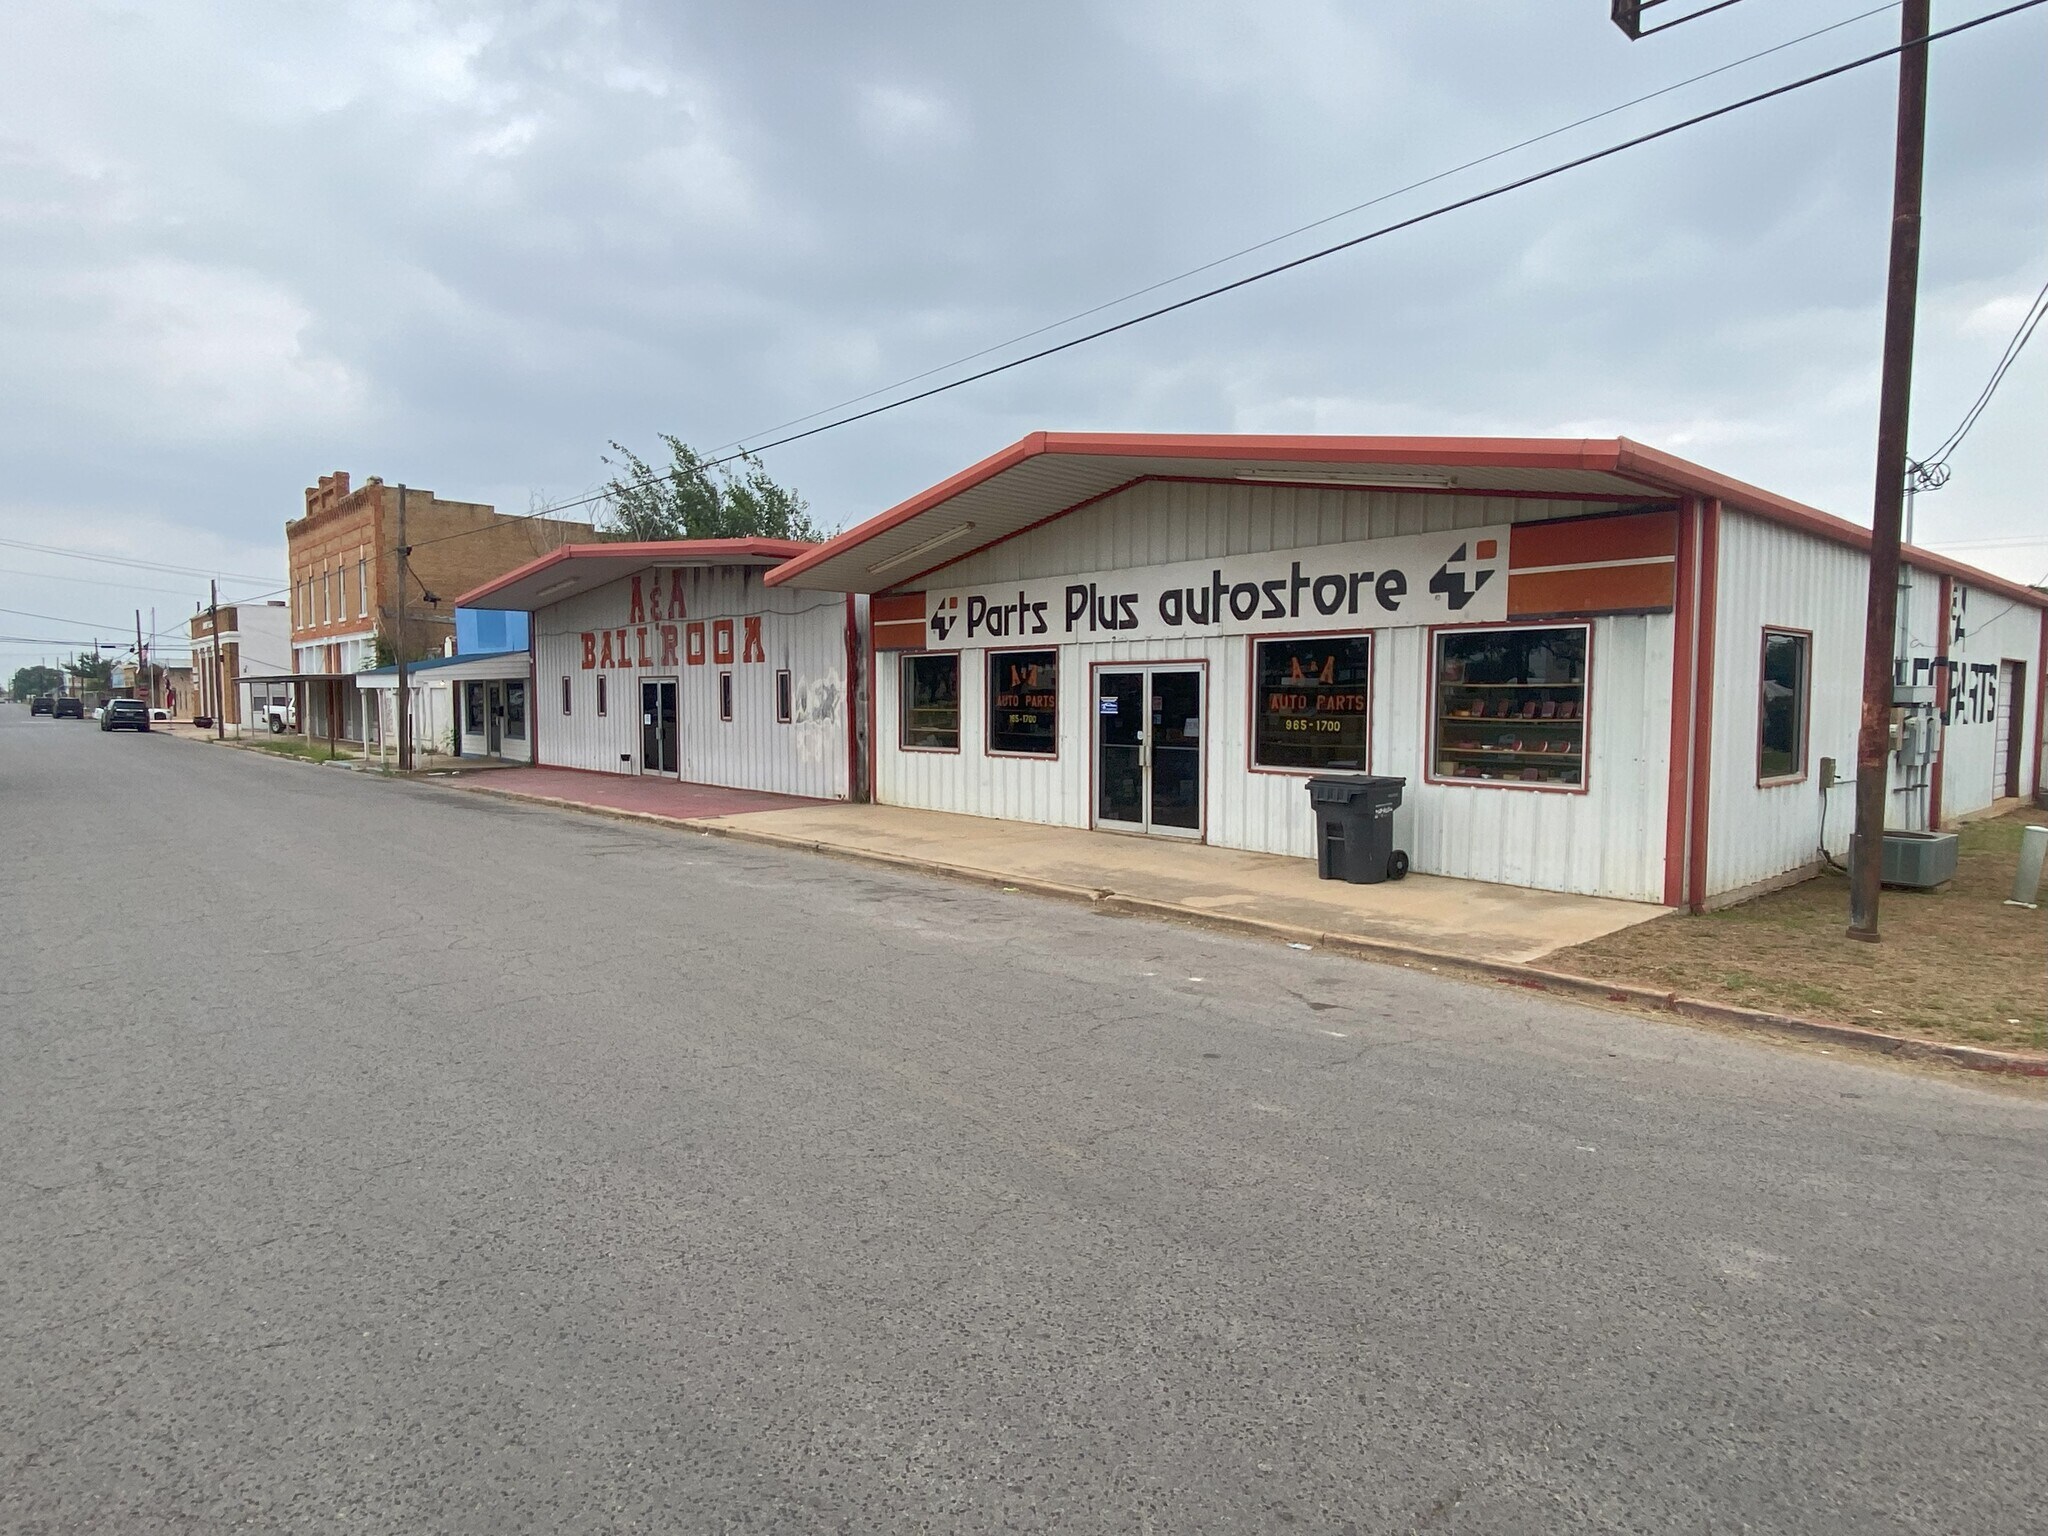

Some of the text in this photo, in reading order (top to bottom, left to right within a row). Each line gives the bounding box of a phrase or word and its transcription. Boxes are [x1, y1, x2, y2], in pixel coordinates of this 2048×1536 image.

[967, 561, 1408, 638] Parts Plus autostore
[996, 695, 1055, 707] AUTO PARTS
[1269, 693, 1365, 711] AUTO PARTS
[1285, 719, 1341, 732] 965-1700
